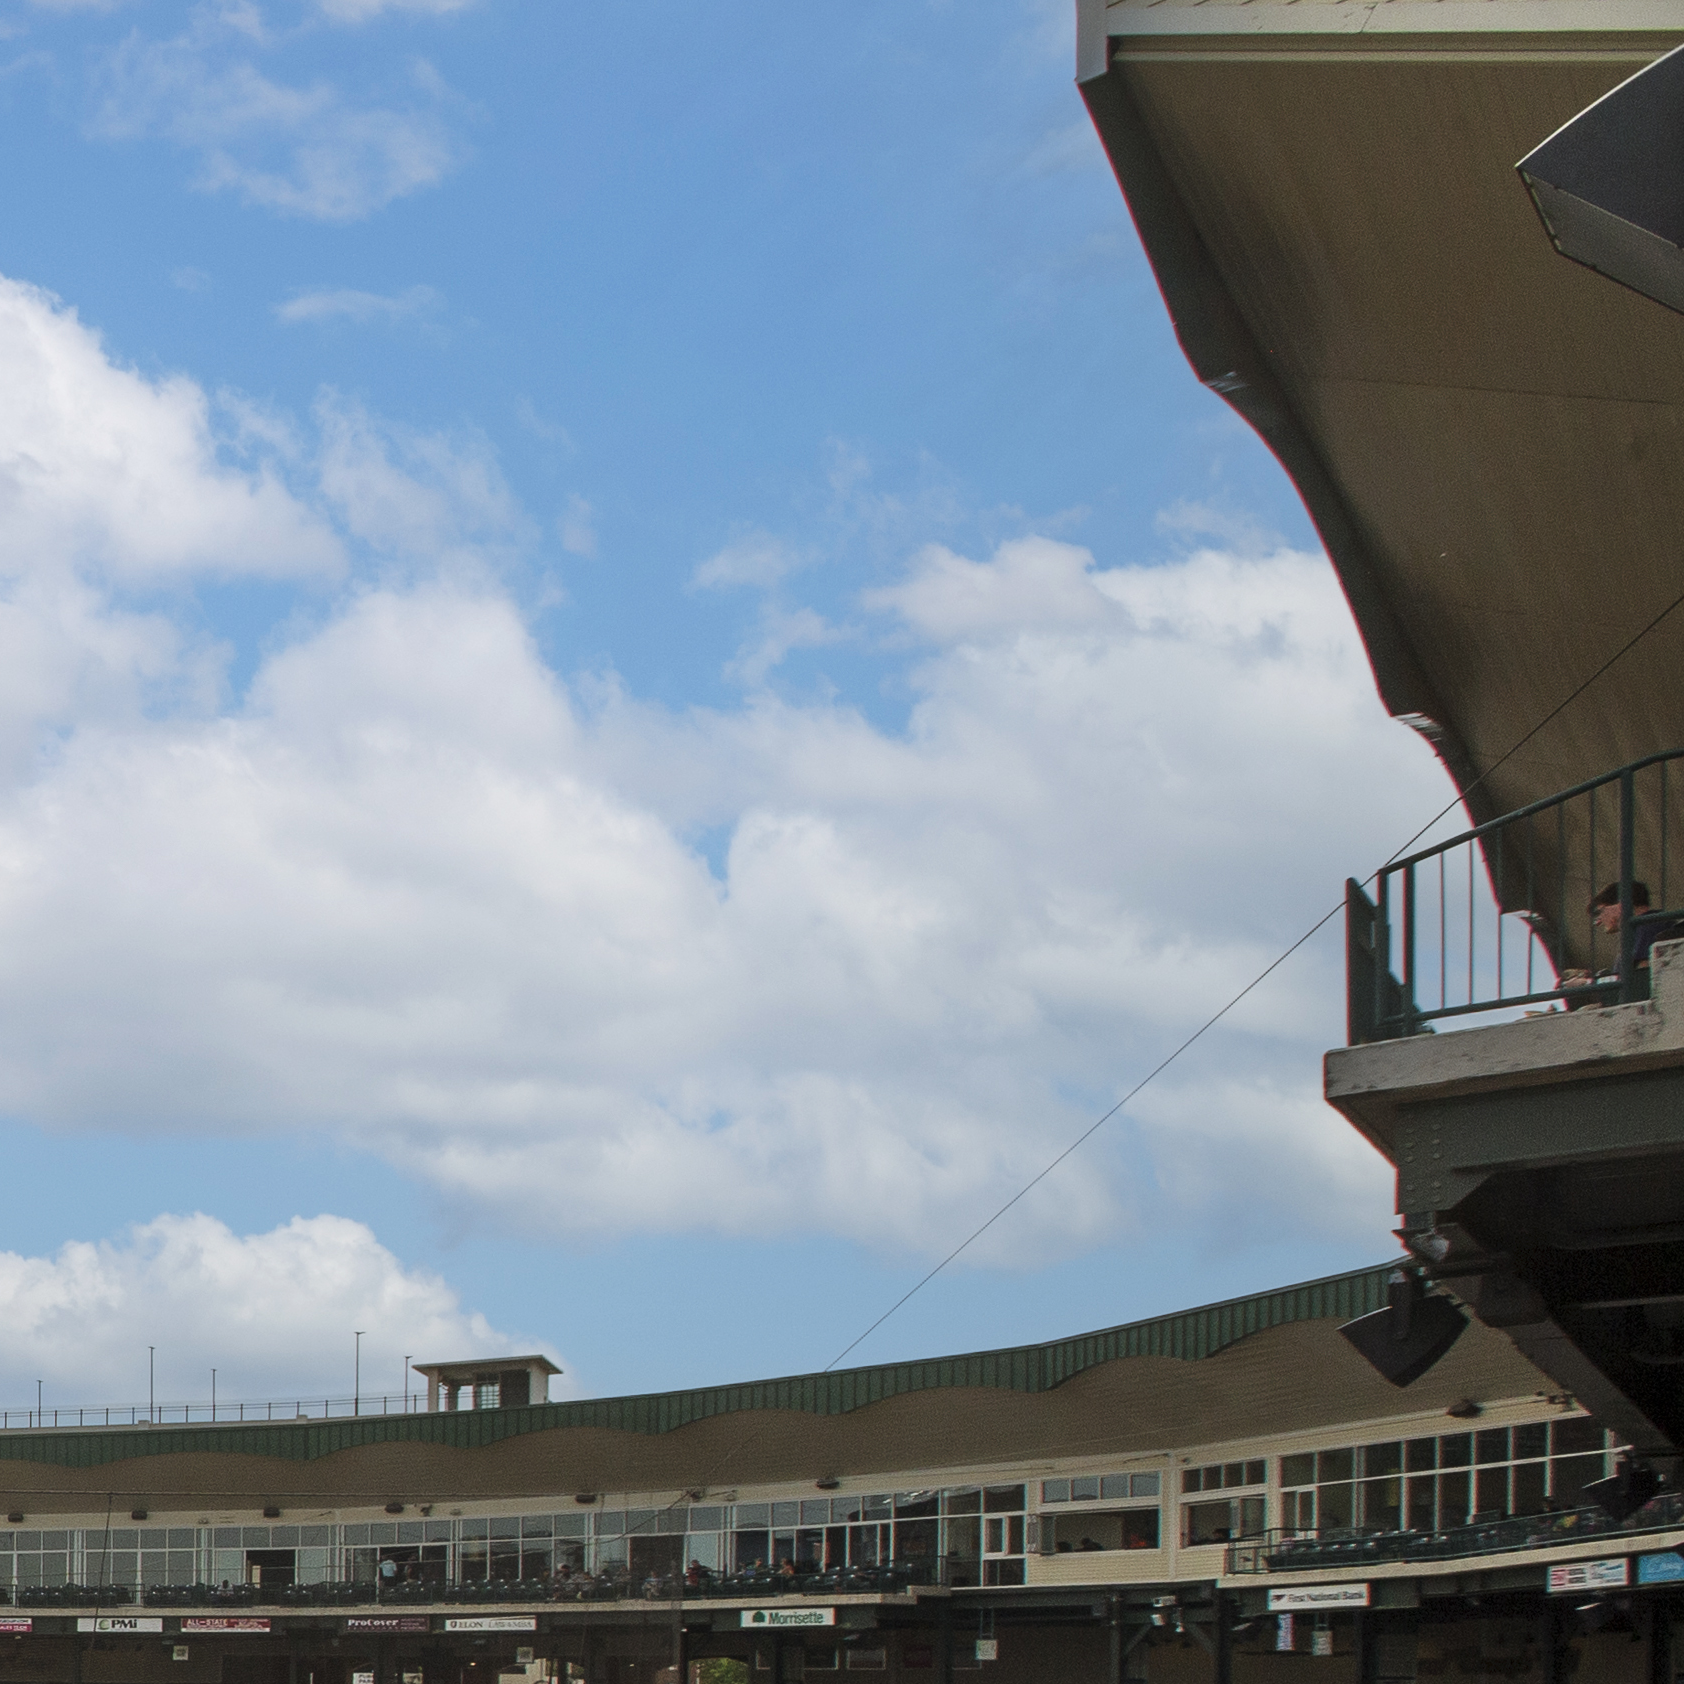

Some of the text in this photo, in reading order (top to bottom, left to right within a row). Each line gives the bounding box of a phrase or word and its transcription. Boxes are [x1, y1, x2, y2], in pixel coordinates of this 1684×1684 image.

[347, 1618, 399, 1627] ProCover
[768, 1611, 823, 1625] Morrisette
[111, 1619, 138, 1629] PMi
[458, 1621, 484, 1629] ELON
